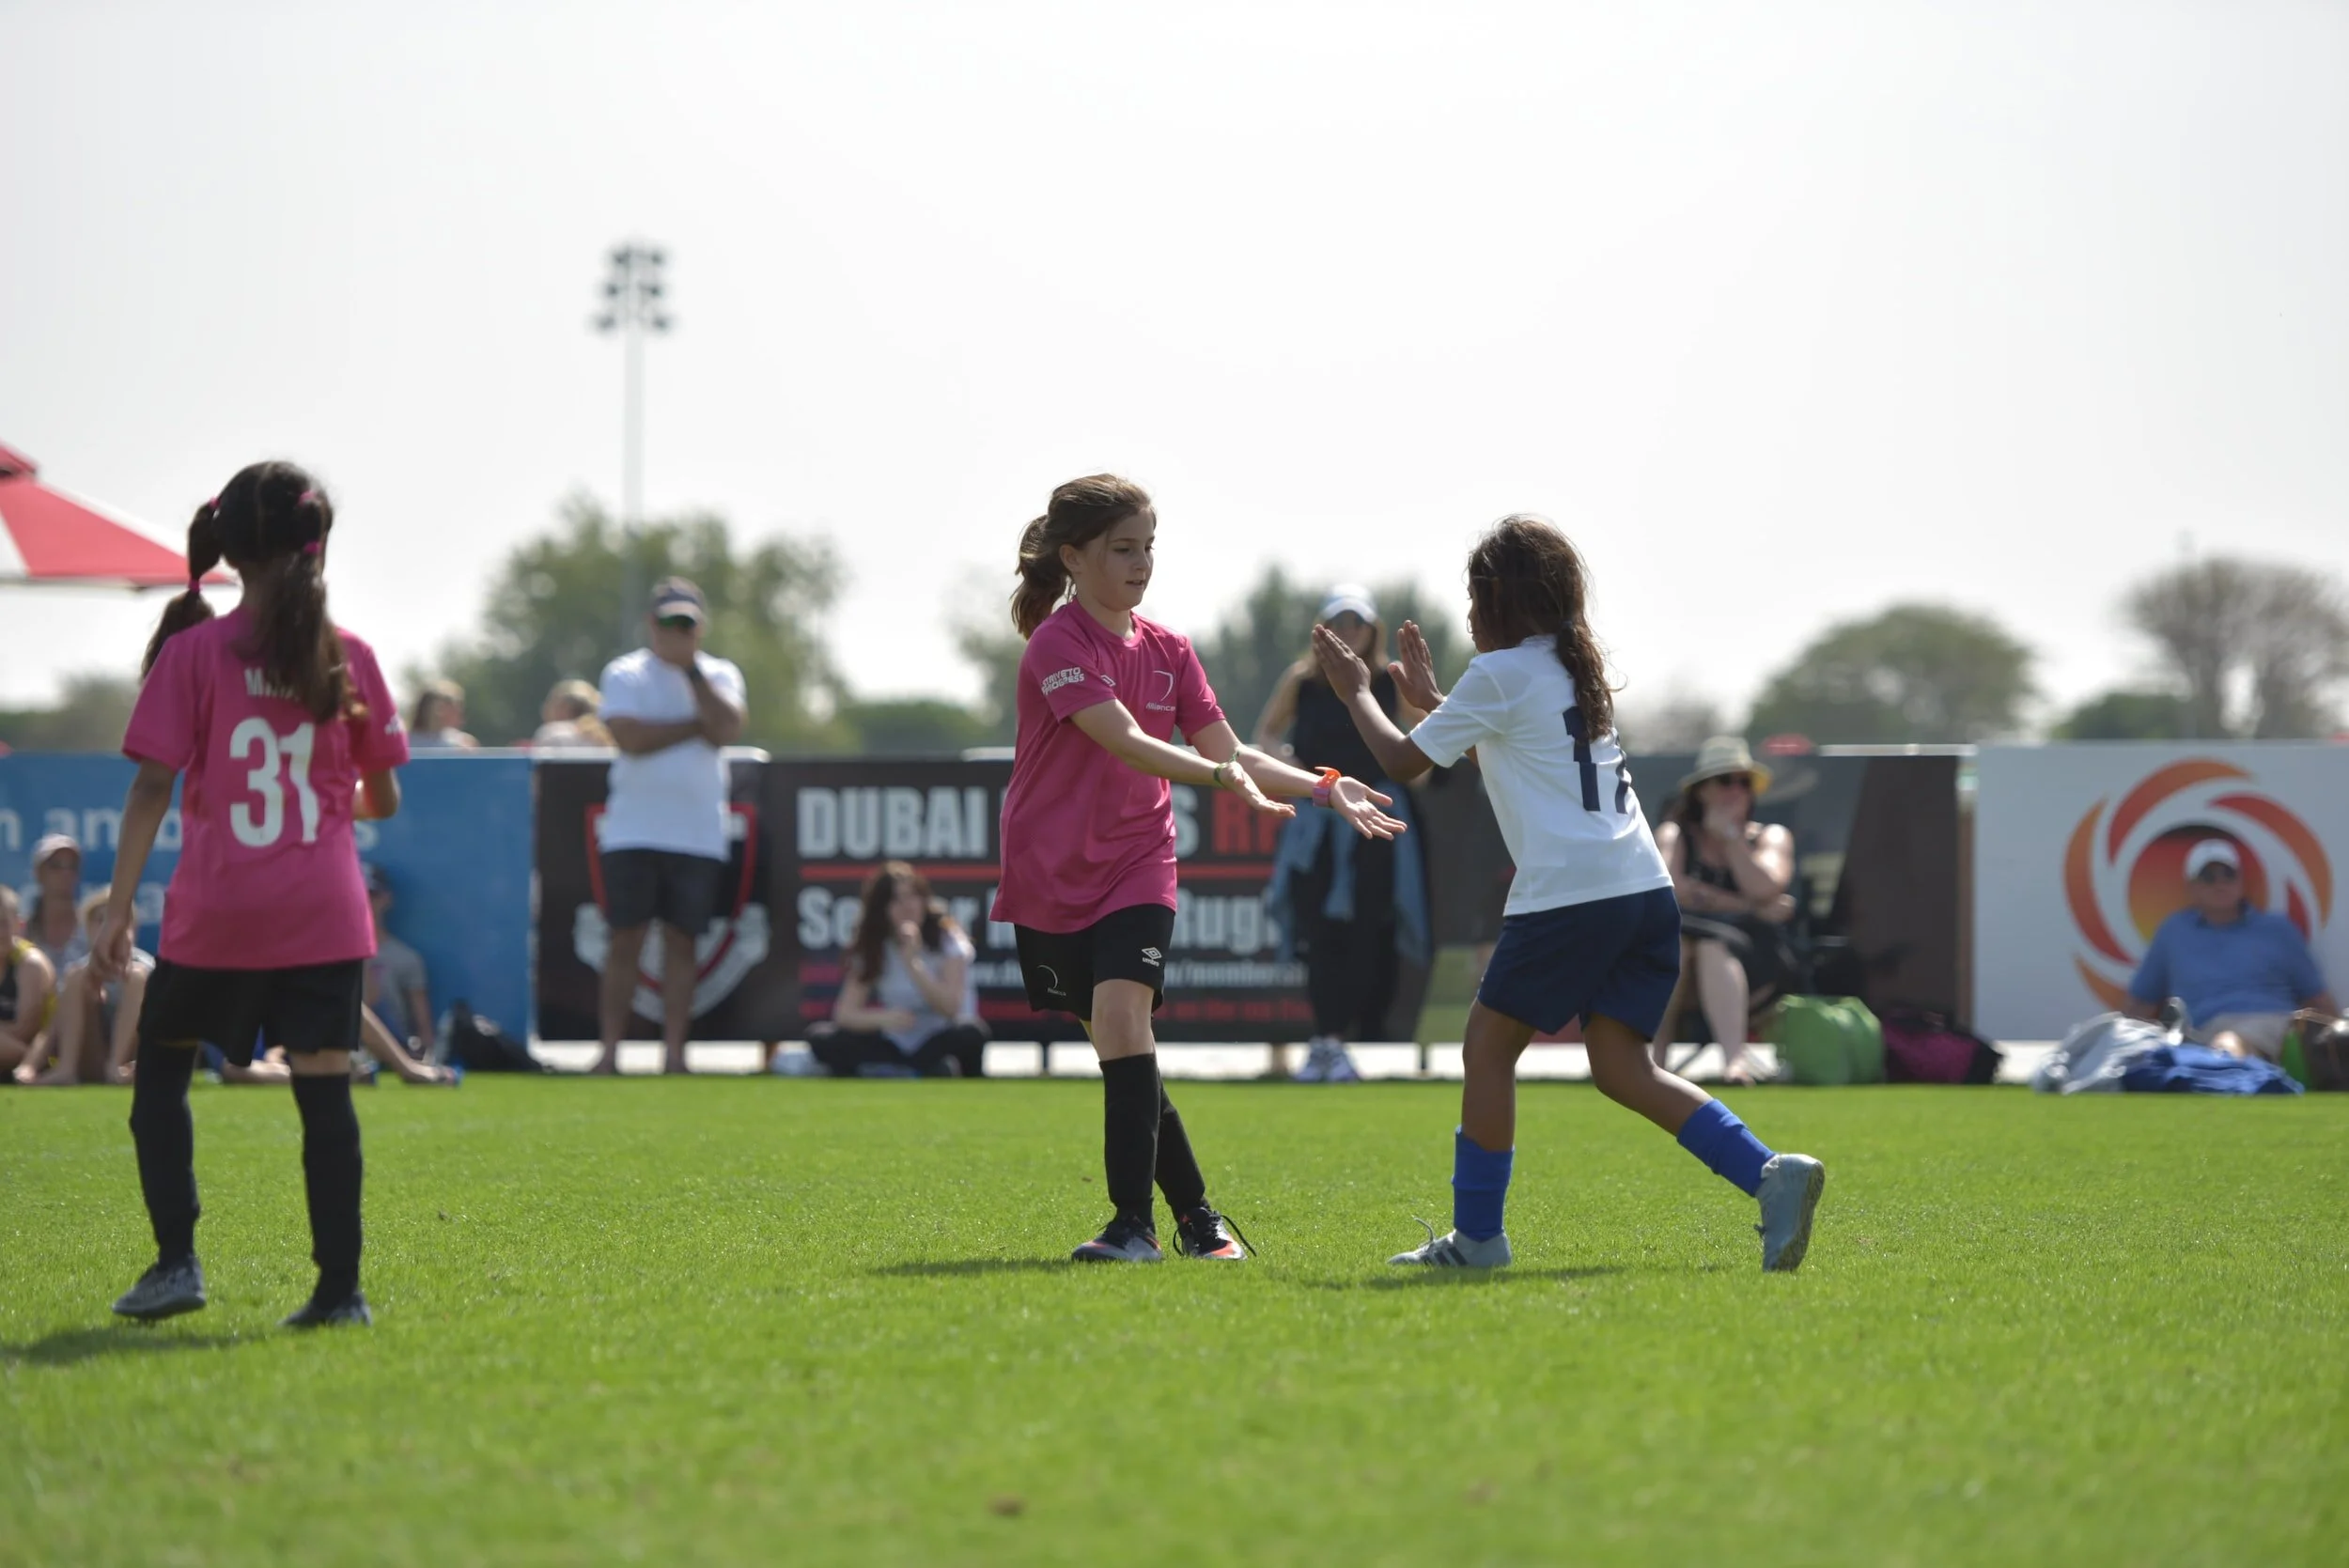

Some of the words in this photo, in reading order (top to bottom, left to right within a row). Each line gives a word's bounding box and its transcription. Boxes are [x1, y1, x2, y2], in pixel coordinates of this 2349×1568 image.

[229, 717, 319, 847] 31
[798, 786, 988, 860] DUBAI
[1142, 956, 1159, 968] umbro
